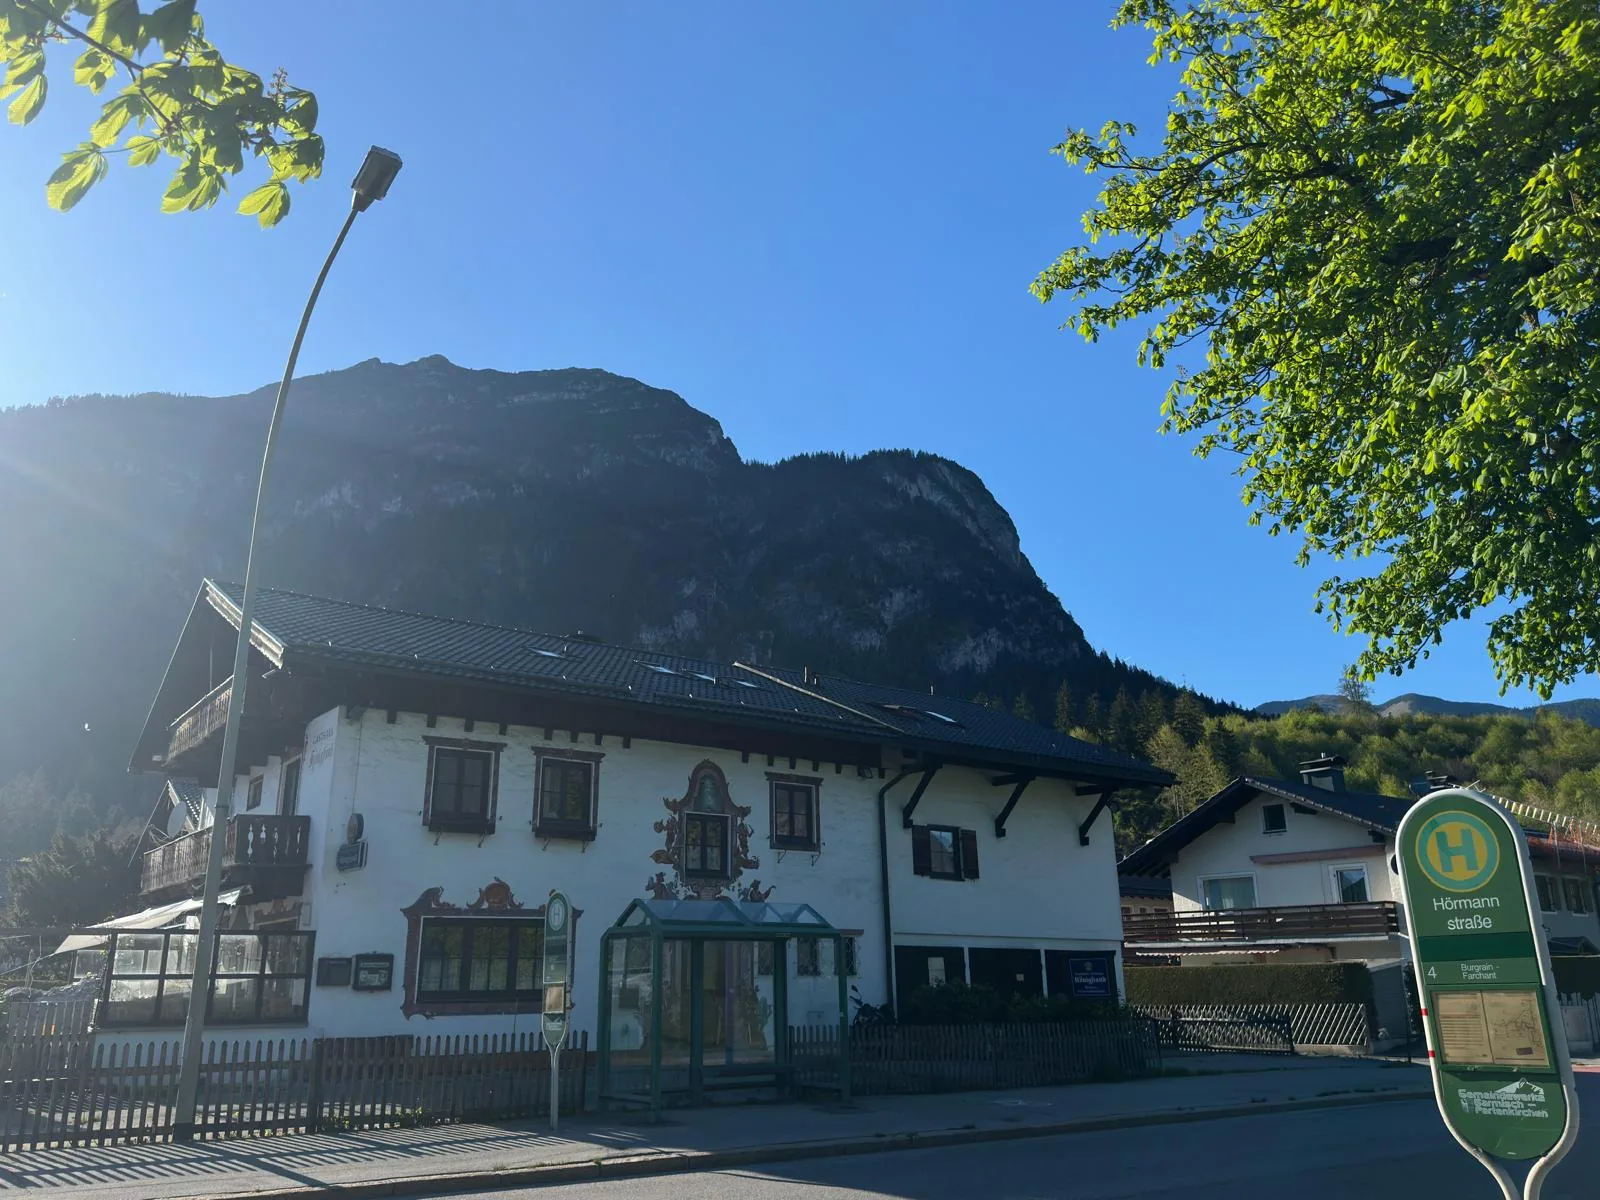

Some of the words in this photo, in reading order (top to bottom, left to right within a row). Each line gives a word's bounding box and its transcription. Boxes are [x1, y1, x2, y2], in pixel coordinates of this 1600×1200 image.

[1435, 828, 1480, 873] H
[1433, 896, 1500, 911] Hörmann
[1447, 915, 1493, 931] straße
[1427, 966, 1438, 979] 4
[1461, 963, 1495, 973] Burgrain
[1462, 972, 1497, 980] Farchant
[1457, 1089, 1546, 1102] Gemeindewerke
[1473, 1099, 1525, 1109] Garmisch
[1475, 1106, 1549, 1118] Partenkirchen
